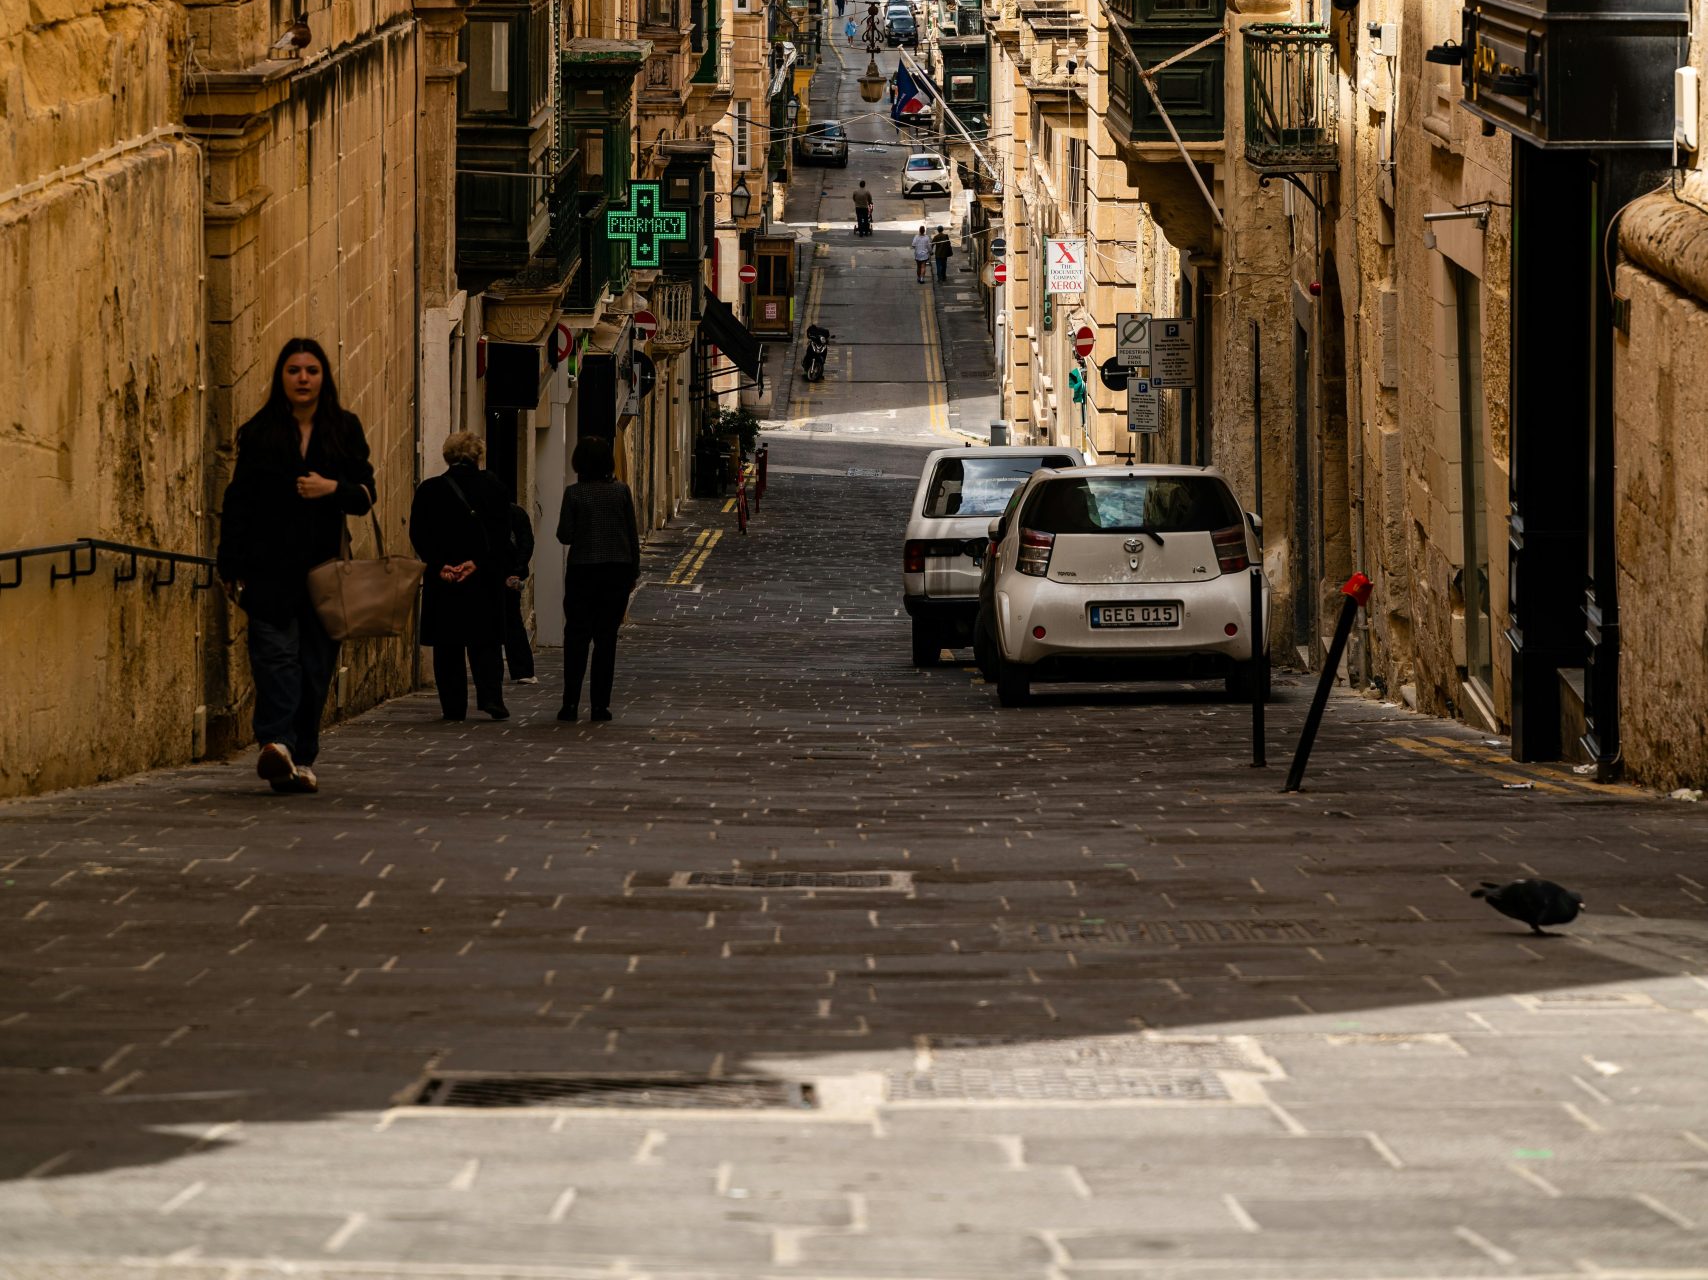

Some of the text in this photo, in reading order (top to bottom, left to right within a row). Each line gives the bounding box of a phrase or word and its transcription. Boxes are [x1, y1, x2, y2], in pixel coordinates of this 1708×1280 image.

[610, 217, 681, 233] PHARMACY
[1050, 281, 1083, 290] XEROX
[1103, 607, 1172, 622] GEG 015
